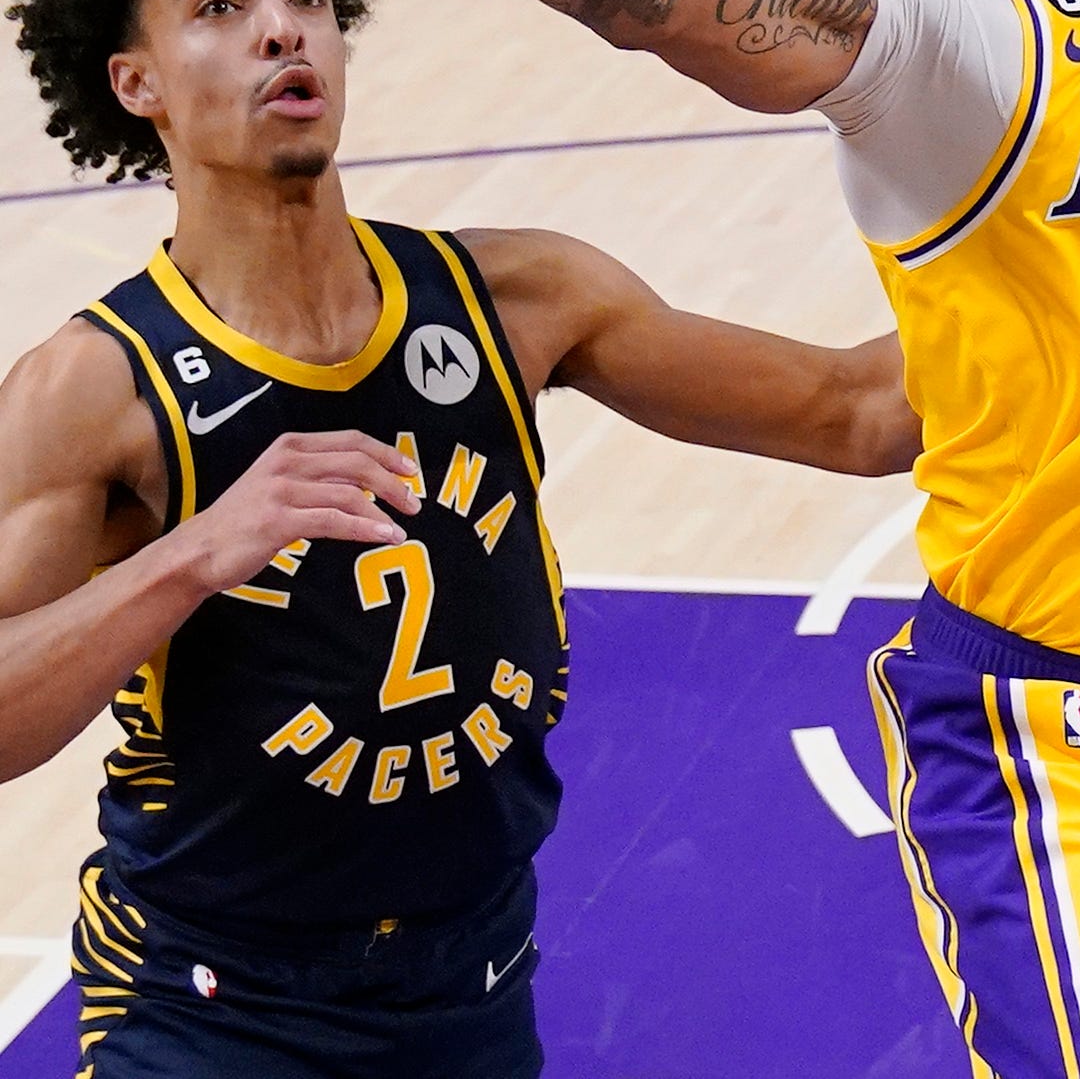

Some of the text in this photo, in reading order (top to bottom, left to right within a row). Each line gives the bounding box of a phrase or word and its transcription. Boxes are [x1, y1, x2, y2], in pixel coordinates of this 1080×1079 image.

[172, 346, 212, 384] 6
[354, 538, 456, 713] 2
[261, 657, 535, 805] PACERS
